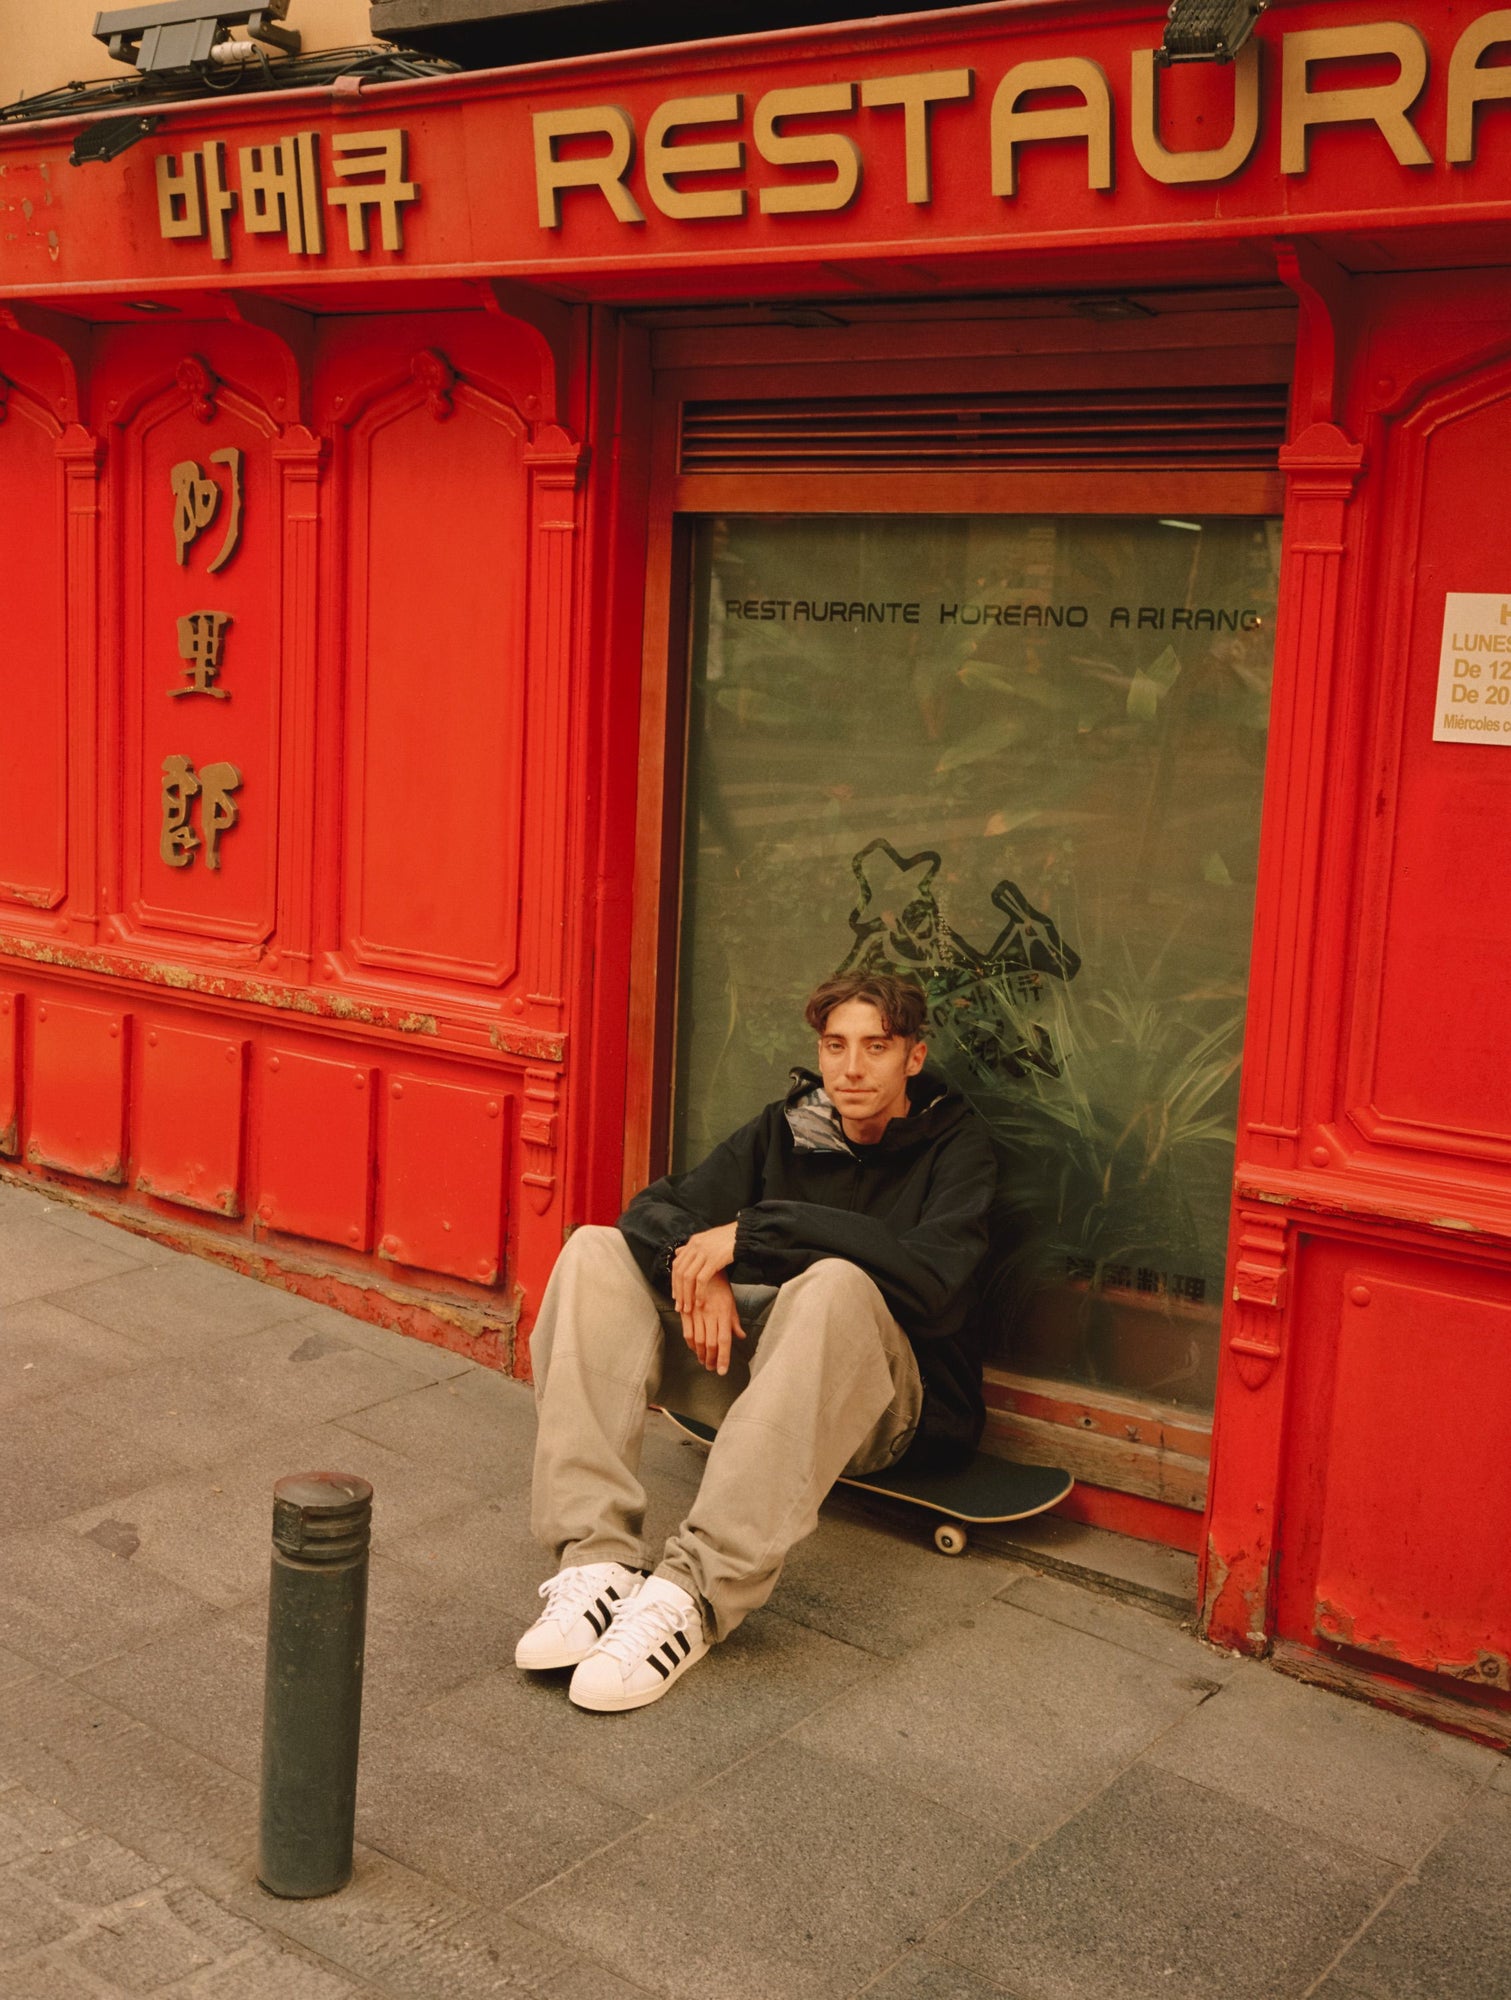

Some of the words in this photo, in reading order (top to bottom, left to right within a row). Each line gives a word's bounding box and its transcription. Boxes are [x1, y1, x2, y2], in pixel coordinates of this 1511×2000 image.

[155, 129, 421, 261] 바베큐
[725, 600, 920, 624] RESTAURANTE
[939, 603, 1088, 628] KOREANO
[1453, 658, 1482, 679] De
[1451, 684, 1479, 704] De
[1443, 713, 1500, 732] Miércoles
